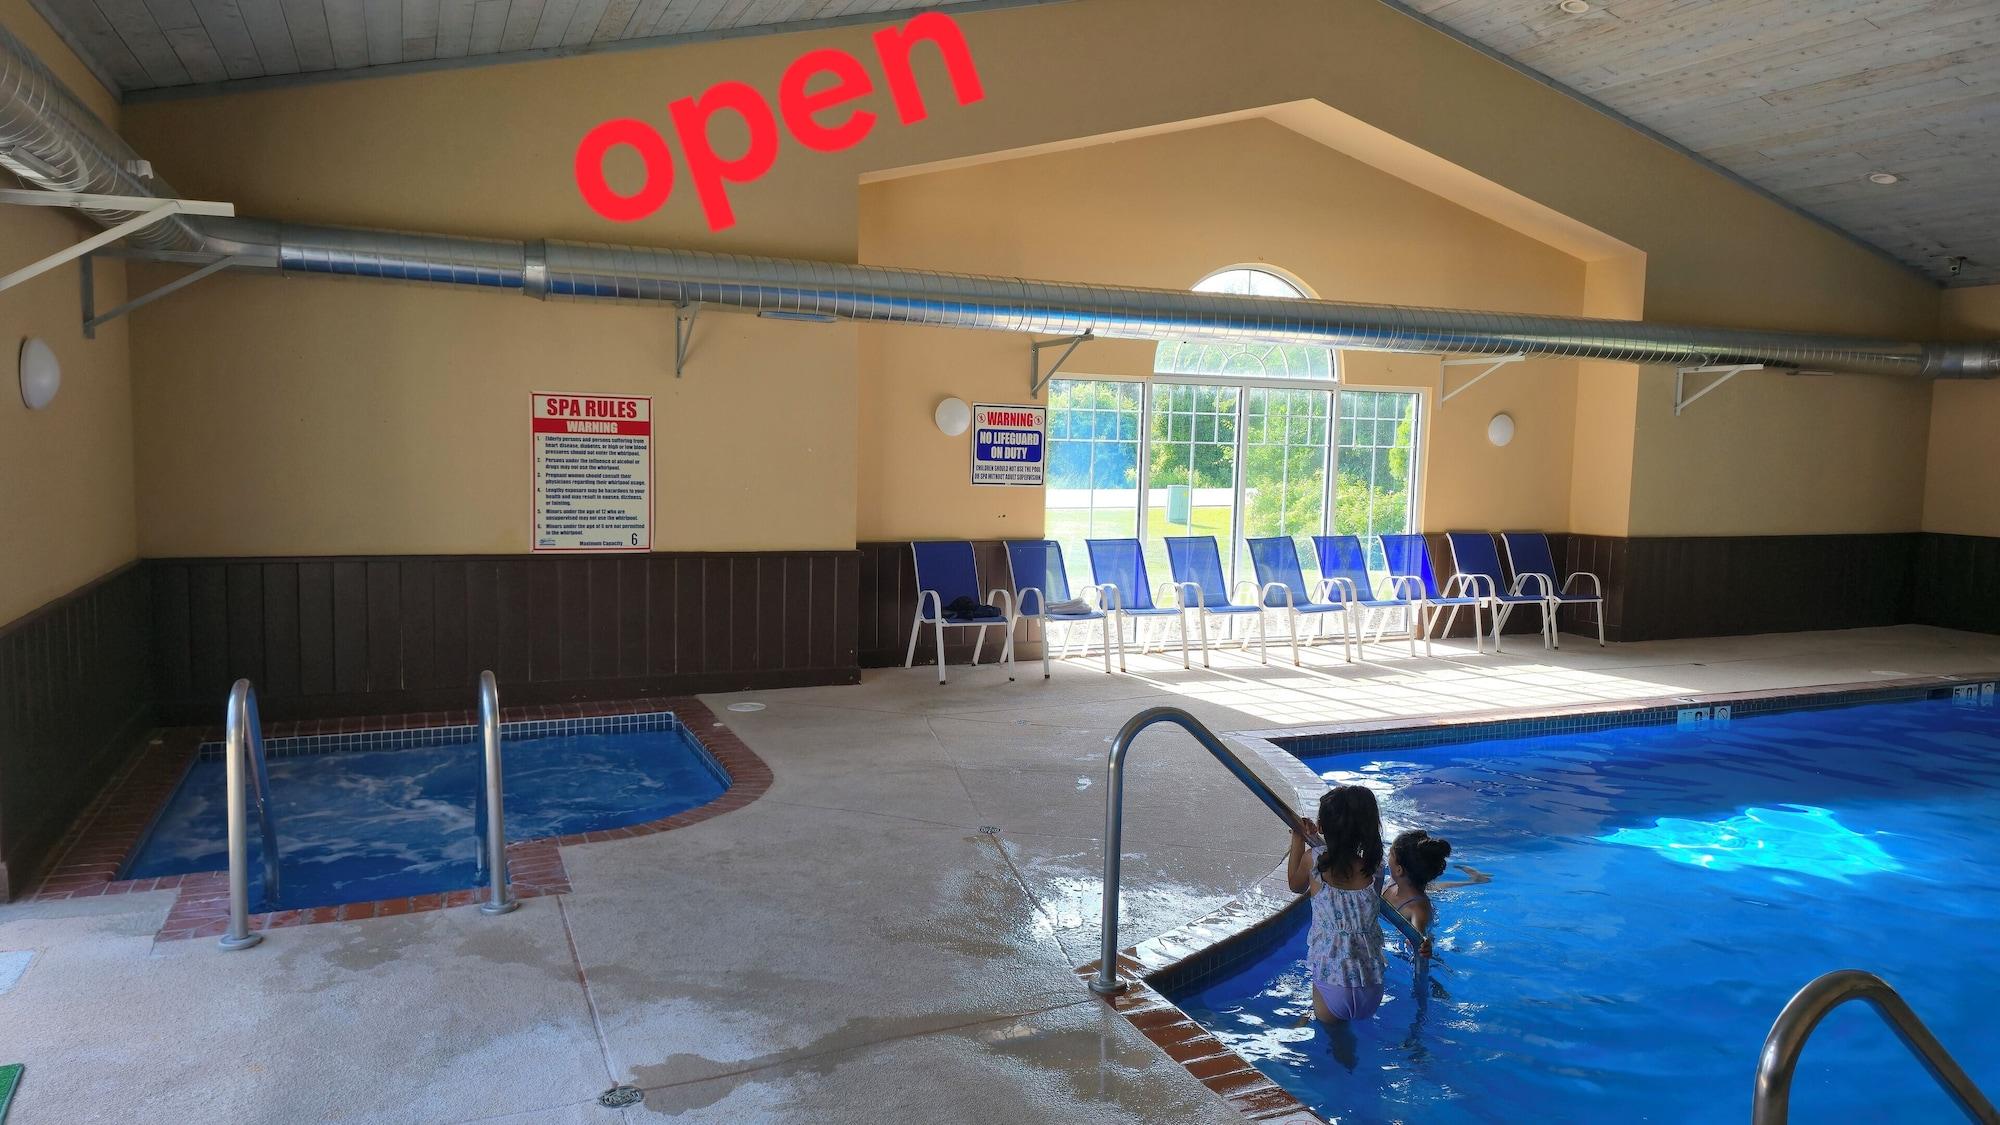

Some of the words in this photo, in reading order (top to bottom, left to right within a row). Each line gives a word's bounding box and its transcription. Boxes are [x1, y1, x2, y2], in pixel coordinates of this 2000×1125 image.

[547, 398, 581, 416] SPA
[585, 400, 637, 418] RULES
[988, 412, 1033, 426] WARNING
[566, 420, 618, 433] WARNING
[980, 432, 992, 444] NO
[993, 432, 1039, 445] LIFEGUARD
[991, 446, 1003, 458] ON
[1004, 447, 1027, 459] DUTY
[631, 533, 638, 545] 6
